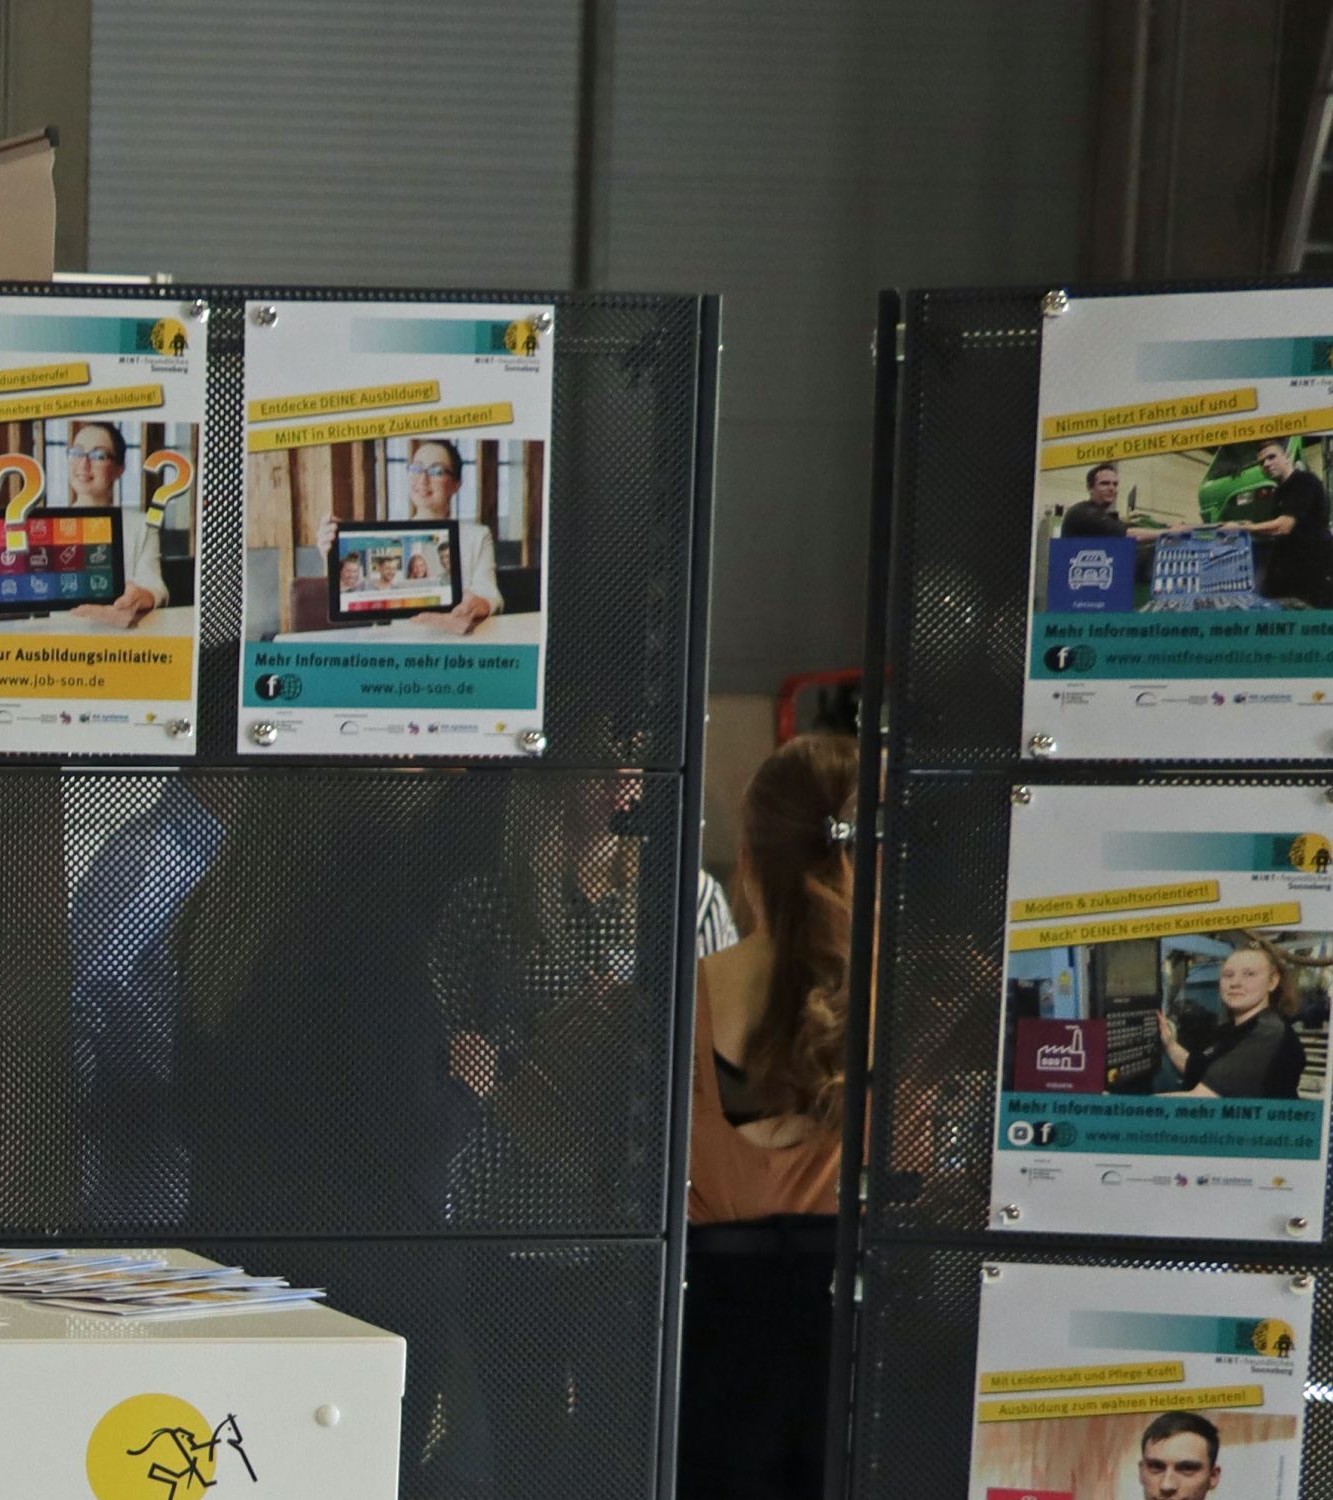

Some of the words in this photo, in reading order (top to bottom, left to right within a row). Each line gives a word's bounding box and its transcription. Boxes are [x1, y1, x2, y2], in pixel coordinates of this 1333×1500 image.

[43, 399, 53, 412] in
[55, 395, 93, 411] Sachen
[96, 389, 156, 408] Ausbildung!
[261, 398, 318, 416] Entdecke
[320, 395, 357, 410] DEINE
[360, 385, 434, 407] Ausbildung!
[275, 428, 310, 444] MINT
[312, 426, 324, 441] in
[329, 420, 385, 440] Richtung
[388, 413, 439, 432] Zukunft
[442, 408, 492, 426] starten!
[1056, 416, 1099, 432] Nimm
[1102, 411, 1134, 429] jetzt
[1139, 405, 1177, 421] Fahrt
[1182, 402, 1205, 416] auf
[1209, 396, 1238, 411] und
[1123, 436, 1166, 453] DEINE
[1171, 428, 1229, 446] Karriere
[1232, 423, 1255, 438] ins
[1259, 416, 1308, 433] rollen!
[1044, 623, 1083, 639] Mehr
[1089, 622, 1204, 640] Informationen,
[1209, 622, 1250, 638] mehr
[1255, 621, 1296, 636] MINT
[15, 648, 173, 664] Ausbildungsinitiative:
[255, 653, 290, 667] Mehr
[295, 653, 399, 669] Informationen,
[404, 653, 439, 668] mehr
[478, 656, 519, 669] unter:
[361, 681, 474, 695] www.job-son.de
[1025, 897, 1073, 914] Modern
[1090, 886, 1209, 909] zukunftsorientiert!
[1081, 923, 1128, 940] DEINEN
[1131, 918, 1171, 934] ersten
[1175, 909, 1274, 930] Karrieresprung!
[1007, 1100, 1046, 1114] Mehr
[1053, 1101, 1169, 1119] Informationen,
[1175, 1104, 1215, 1119] mehr
[1221, 1105, 1262, 1120] MINT
[1267, 1107, 1316, 1122] unter:
[1011, 1371, 1082, 1386] Leidenschaft
[1084, 1369, 1105, 1382] und
[999, 1399, 1068, 1417] Ausbildung
[1072, 1401, 1097, 1412] zum
[1149, 1392, 1194, 1406] Helden
[1197, 1389, 1246, 1403] starten!
